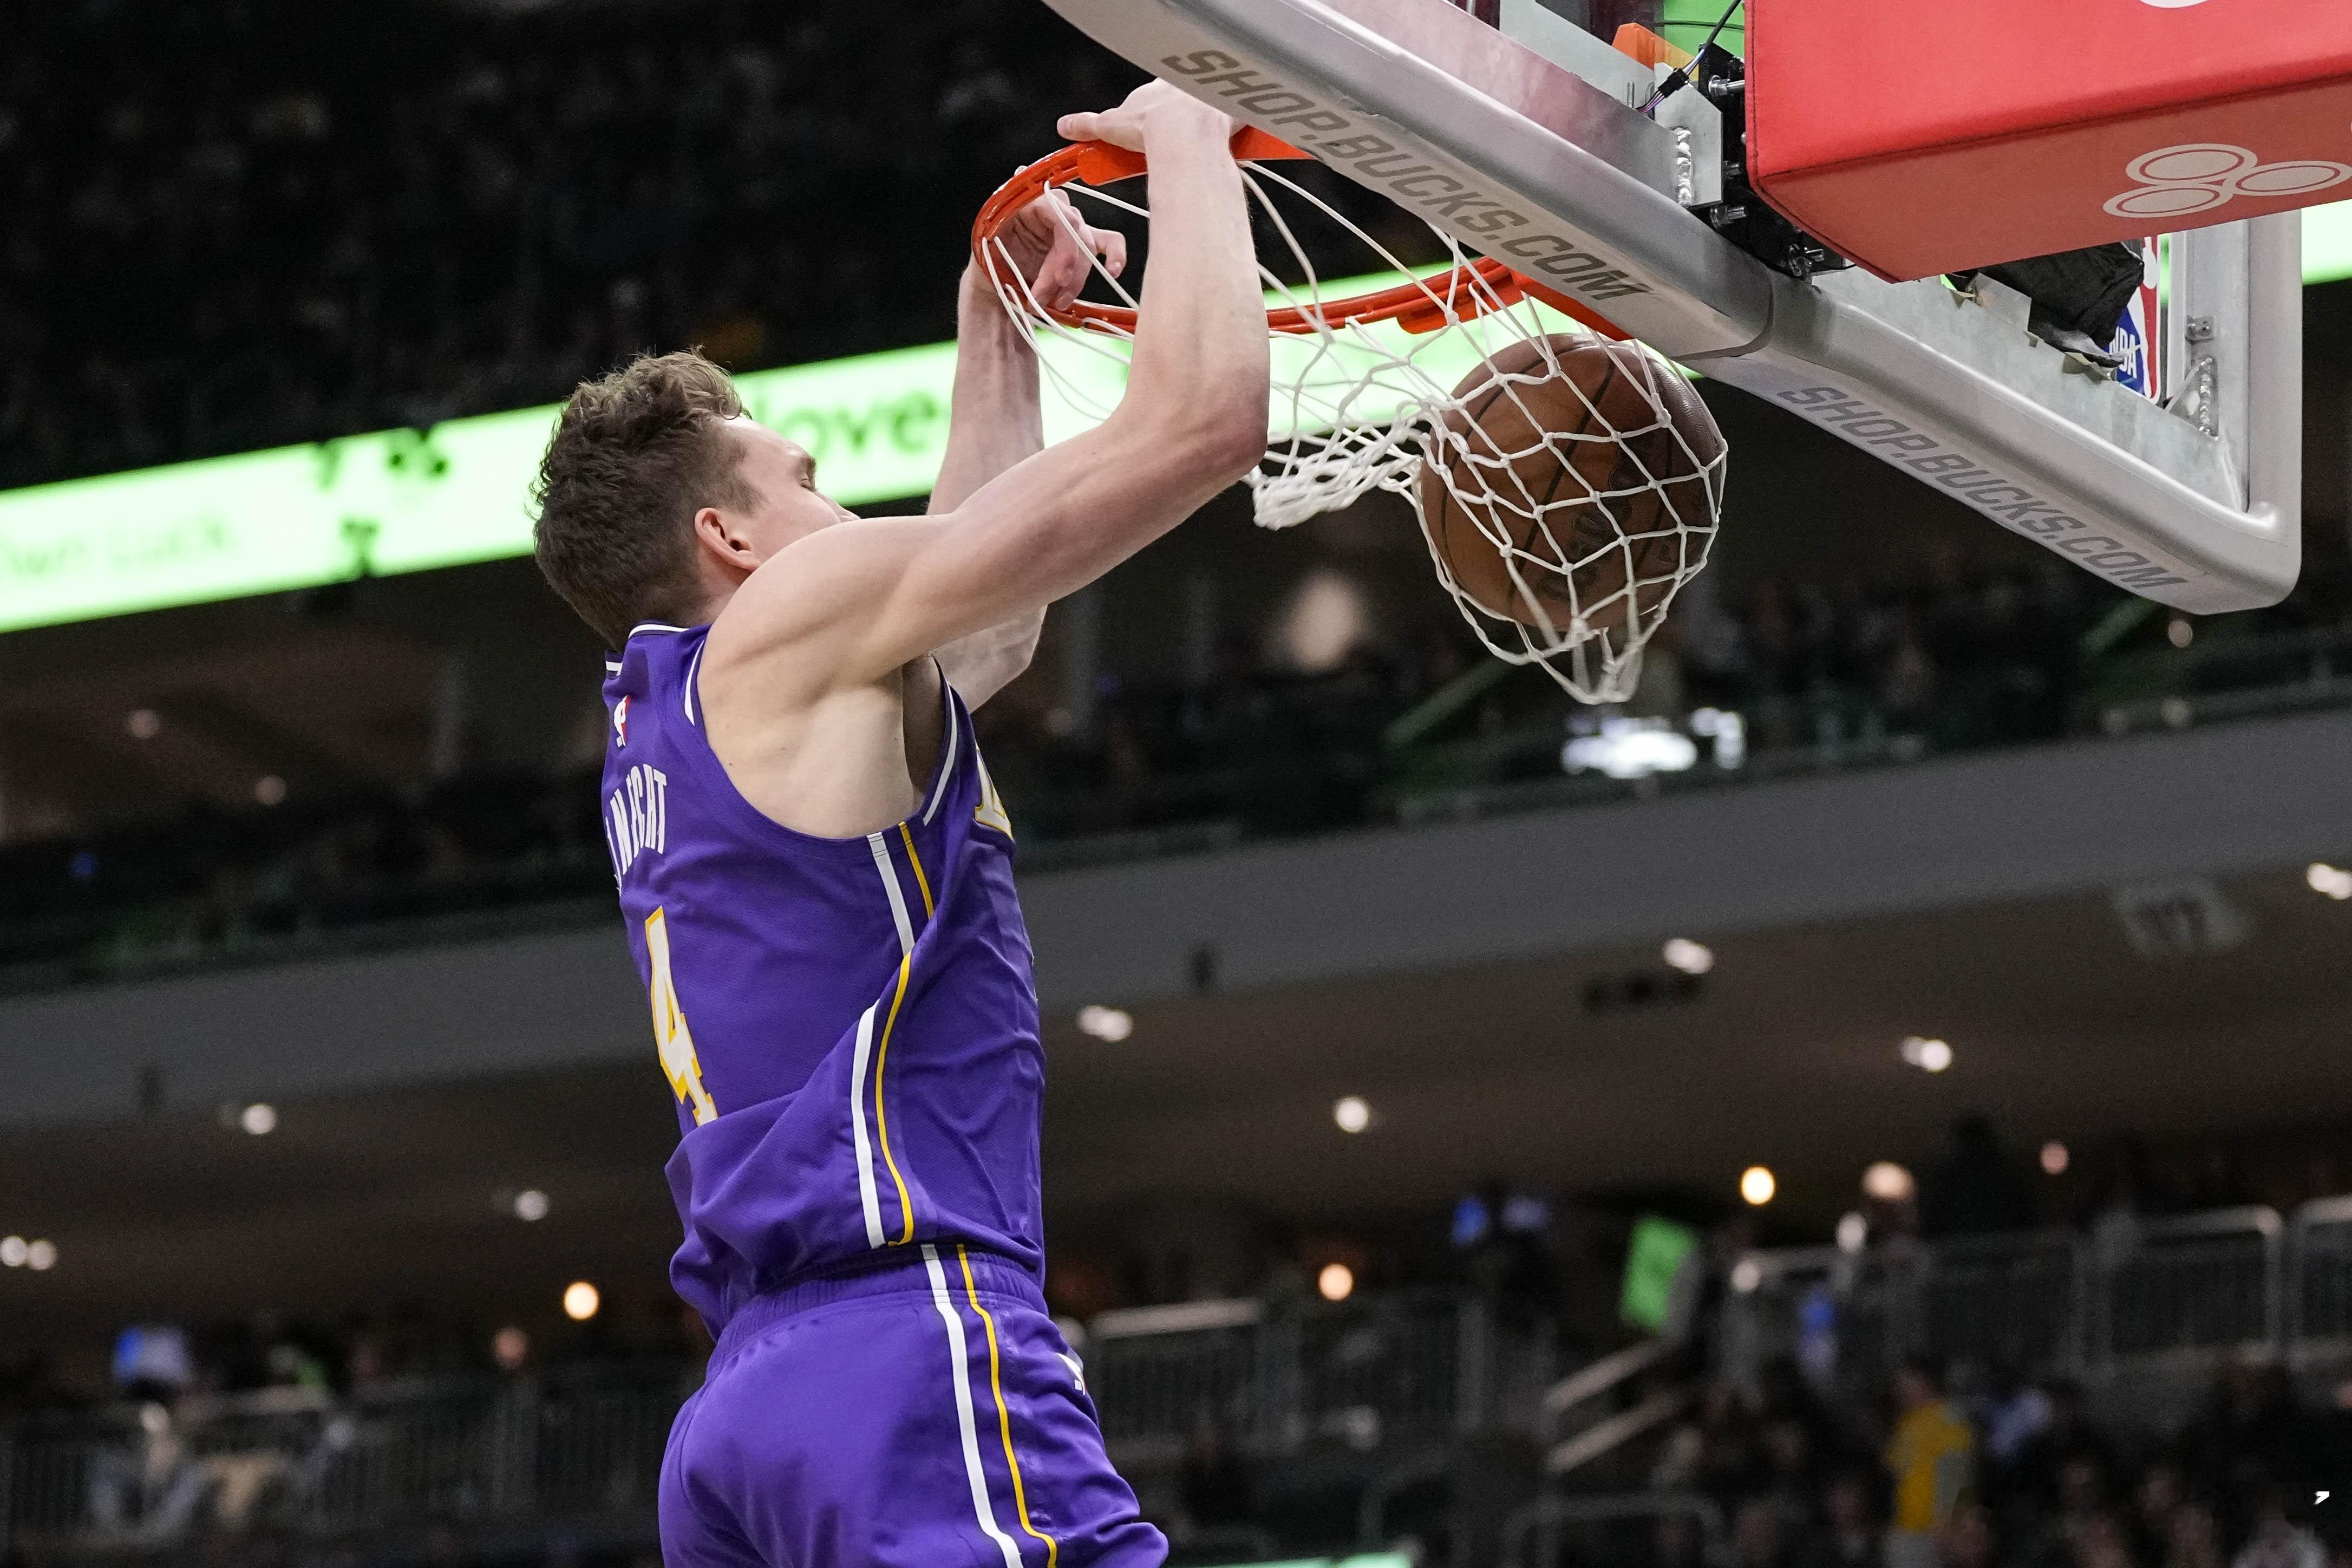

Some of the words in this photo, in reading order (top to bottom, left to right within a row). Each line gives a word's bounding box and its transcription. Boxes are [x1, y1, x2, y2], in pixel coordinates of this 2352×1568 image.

[1160, 49, 1654, 300] SHOP.BUCKS.COM
[1776, 386, 2188, 591] SHOP.BUCKS.COM
[645, 905, 718, 1127] 4
